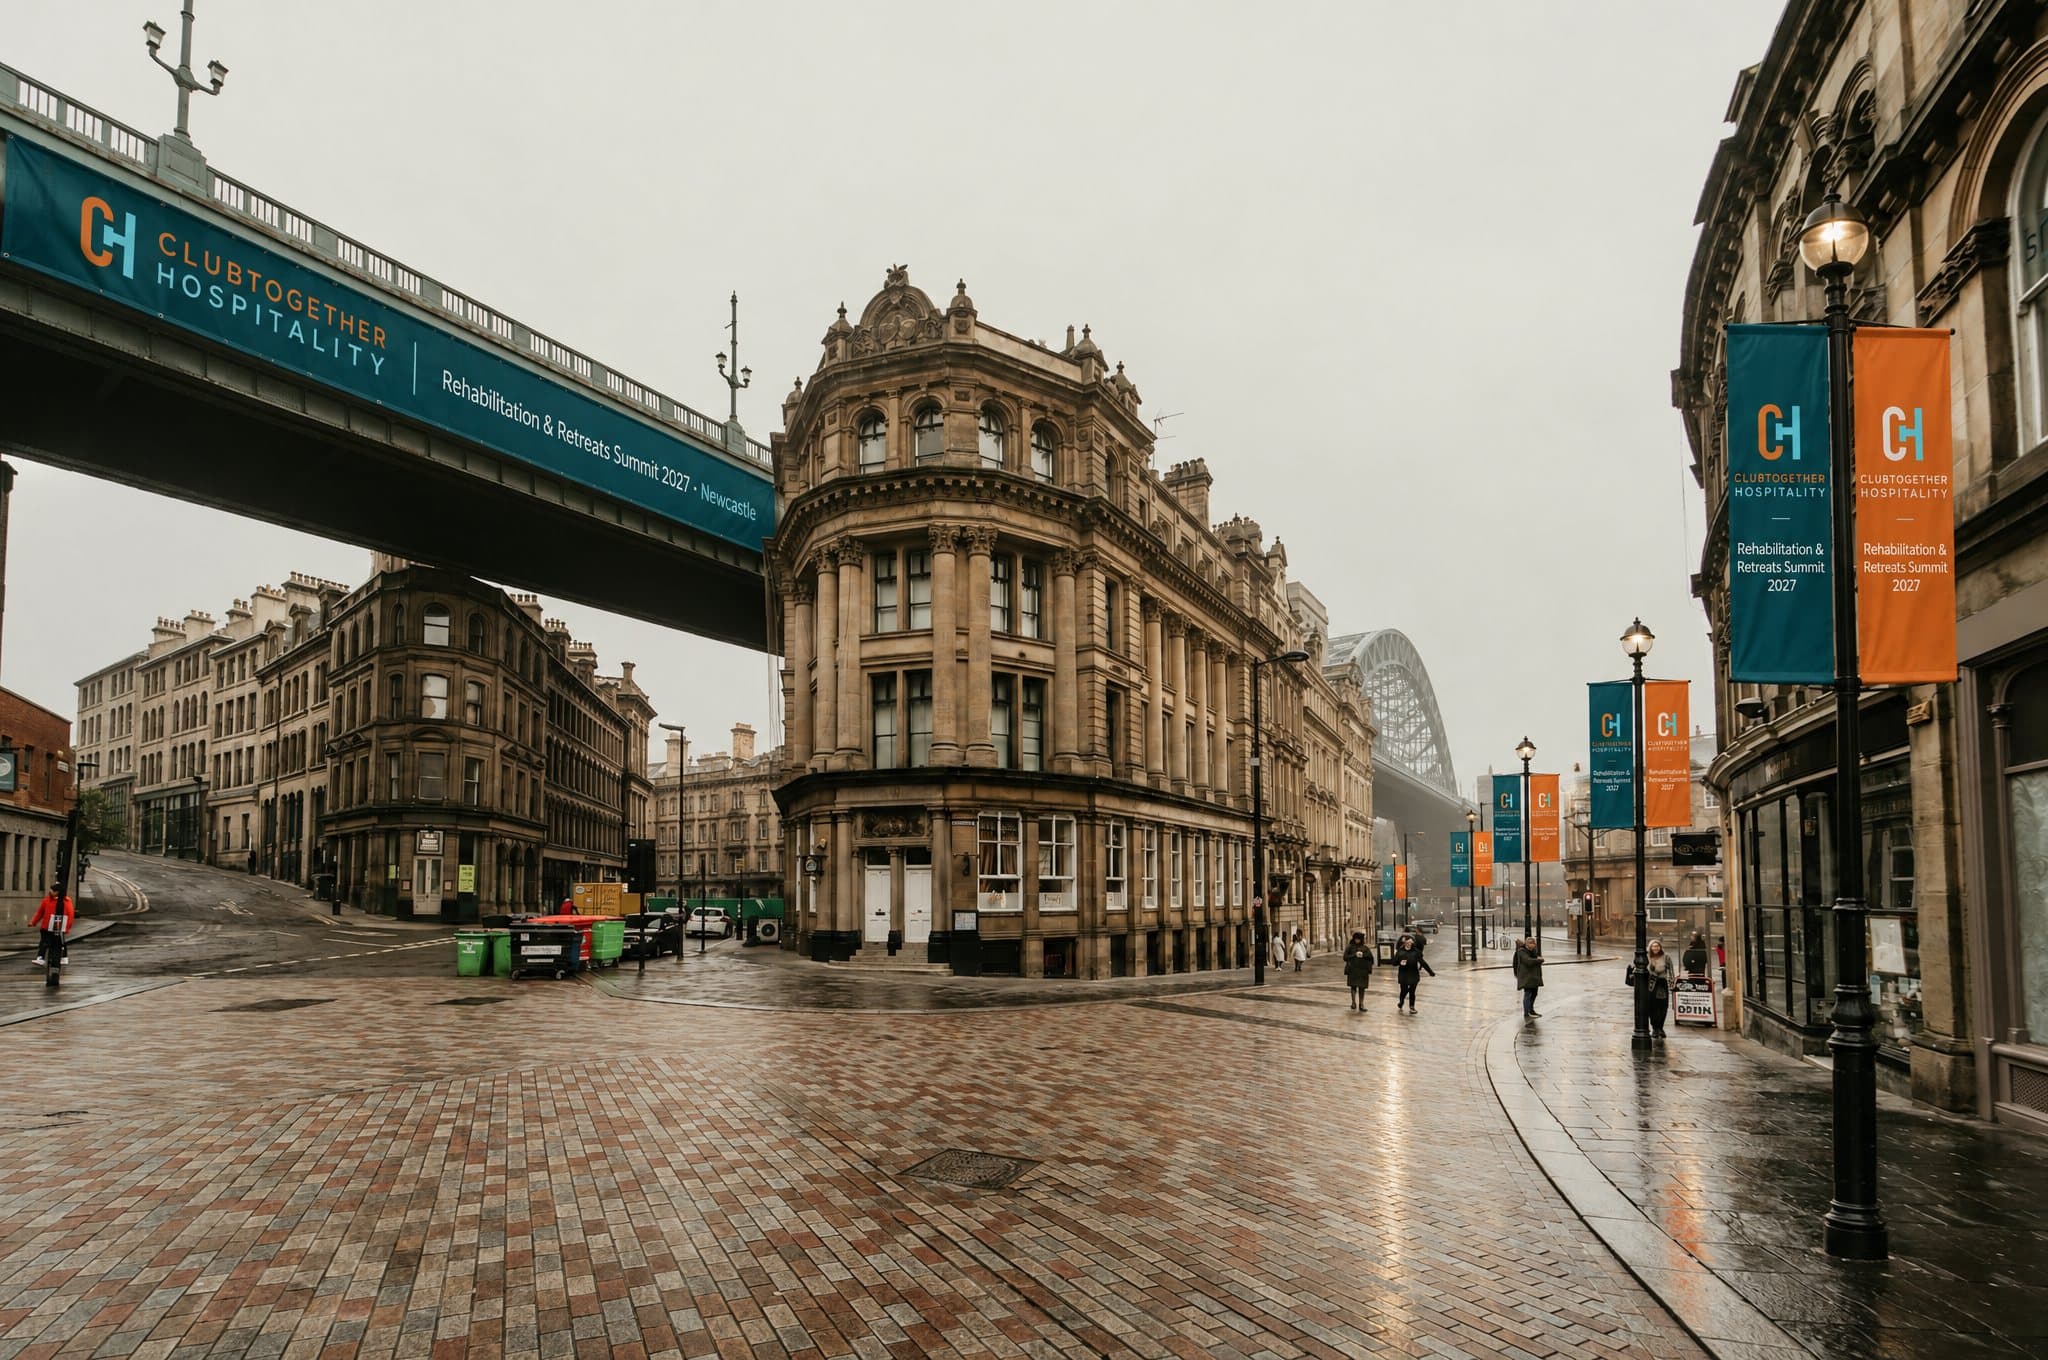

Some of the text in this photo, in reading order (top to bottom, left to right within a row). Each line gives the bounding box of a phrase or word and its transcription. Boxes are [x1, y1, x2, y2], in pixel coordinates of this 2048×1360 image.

[80, 196, 137, 280] CH
[158, 232, 386, 348] CLUBTOGETHER
[157, 262, 385, 375] HOSPITALITY
[1757, 403, 1801, 461] CH
[1882, 406, 1924, 461] CH
[442, 369, 757, 521] Rehabilitation & Retreats Summit 2027 Newcastle
[1734, 473, 1826, 484] CLUBTOGETHER
[1860, 474, 1948, 485] CLUBTOGETHER
[1734, 486, 1826, 498] HOSPITALITY
[1860, 488, 1948, 499] HOSPITALITY
[1737, 542, 1824, 556] Rehabilitation &
[1863, 543, 1947, 556] Rehabilitation &
[1737, 561, 1825, 574] Retreats Summit
[1863, 561, 1948, 574] Retreats Summit
[1767, 579, 1797, 592] 2027
[1892, 579, 1921, 592] 2027
[1601, 713, 1621, 738] CH
[1657, 712, 1677, 737] CH
